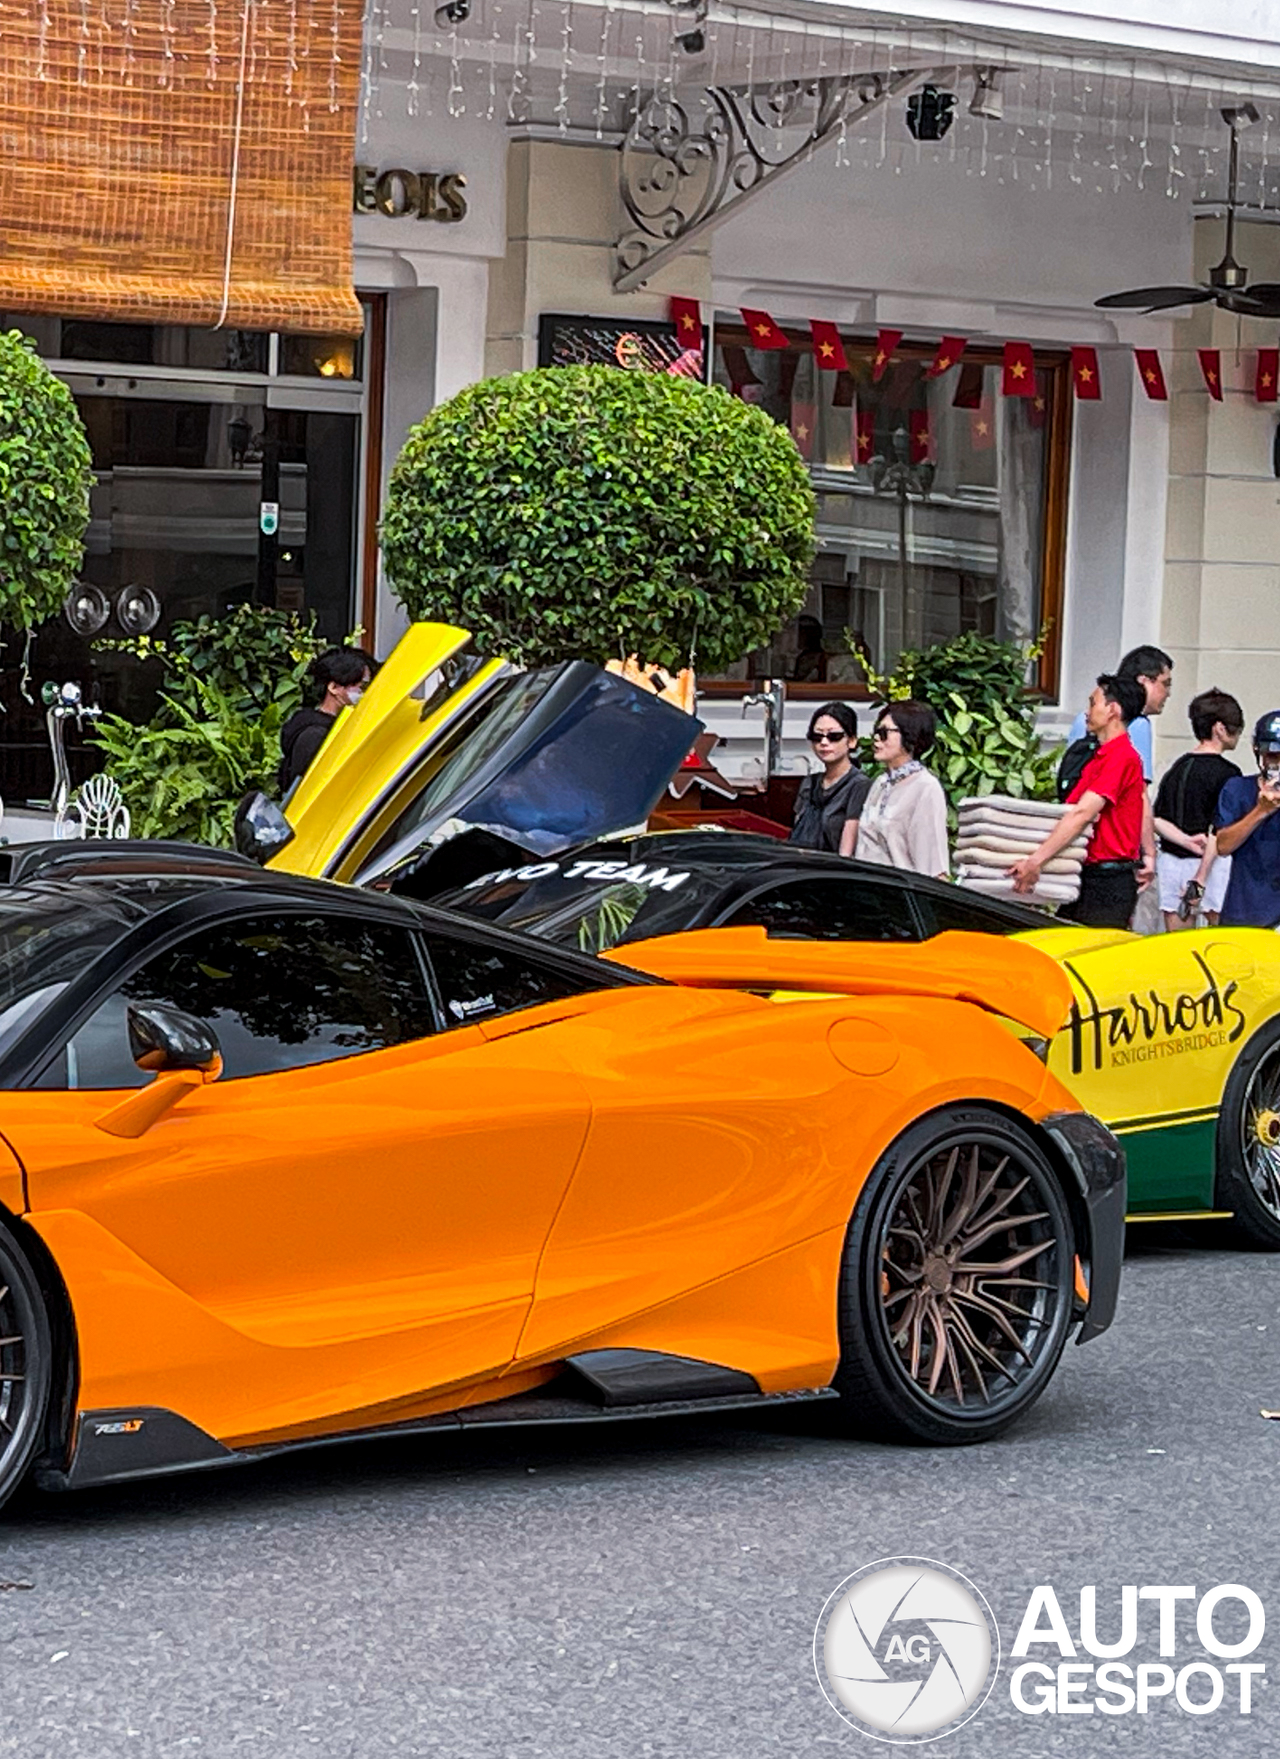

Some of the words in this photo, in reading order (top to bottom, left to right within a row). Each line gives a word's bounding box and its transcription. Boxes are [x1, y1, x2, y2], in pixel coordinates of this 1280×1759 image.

[563, 861, 691, 891] TEAM
[1058, 950, 1245, 1074] Harrods
[1111, 1030, 1227, 1068] KNIGHTSBRIDGE
